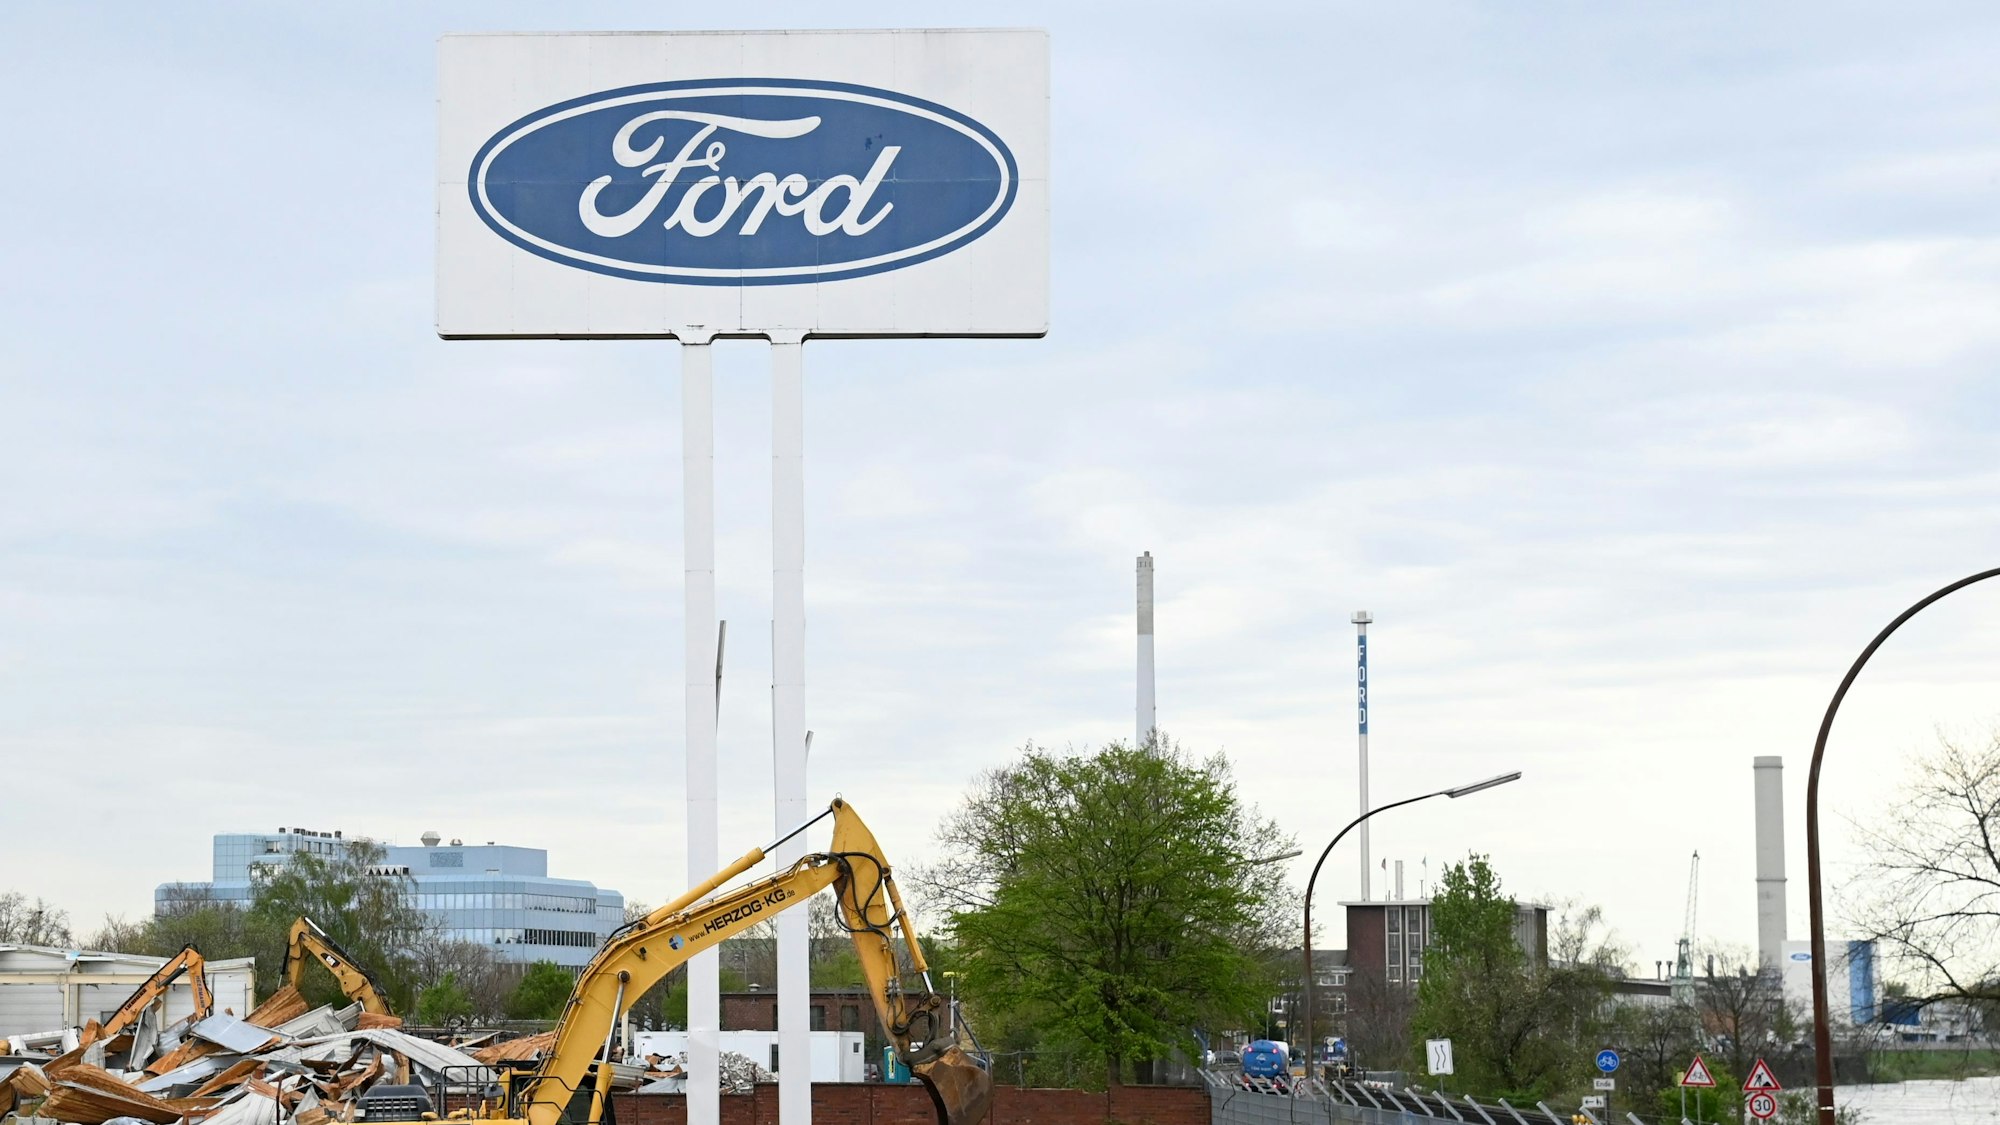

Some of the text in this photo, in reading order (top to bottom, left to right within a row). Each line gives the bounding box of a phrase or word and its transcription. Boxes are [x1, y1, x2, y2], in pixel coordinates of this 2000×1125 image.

[578, 109, 902, 238] Ford
[1358, 644, 1366, 725] FORD
[688, 888, 796, 943] www.HERZOG-KG.de
[1754, 1099, 1771, 1112] 30
